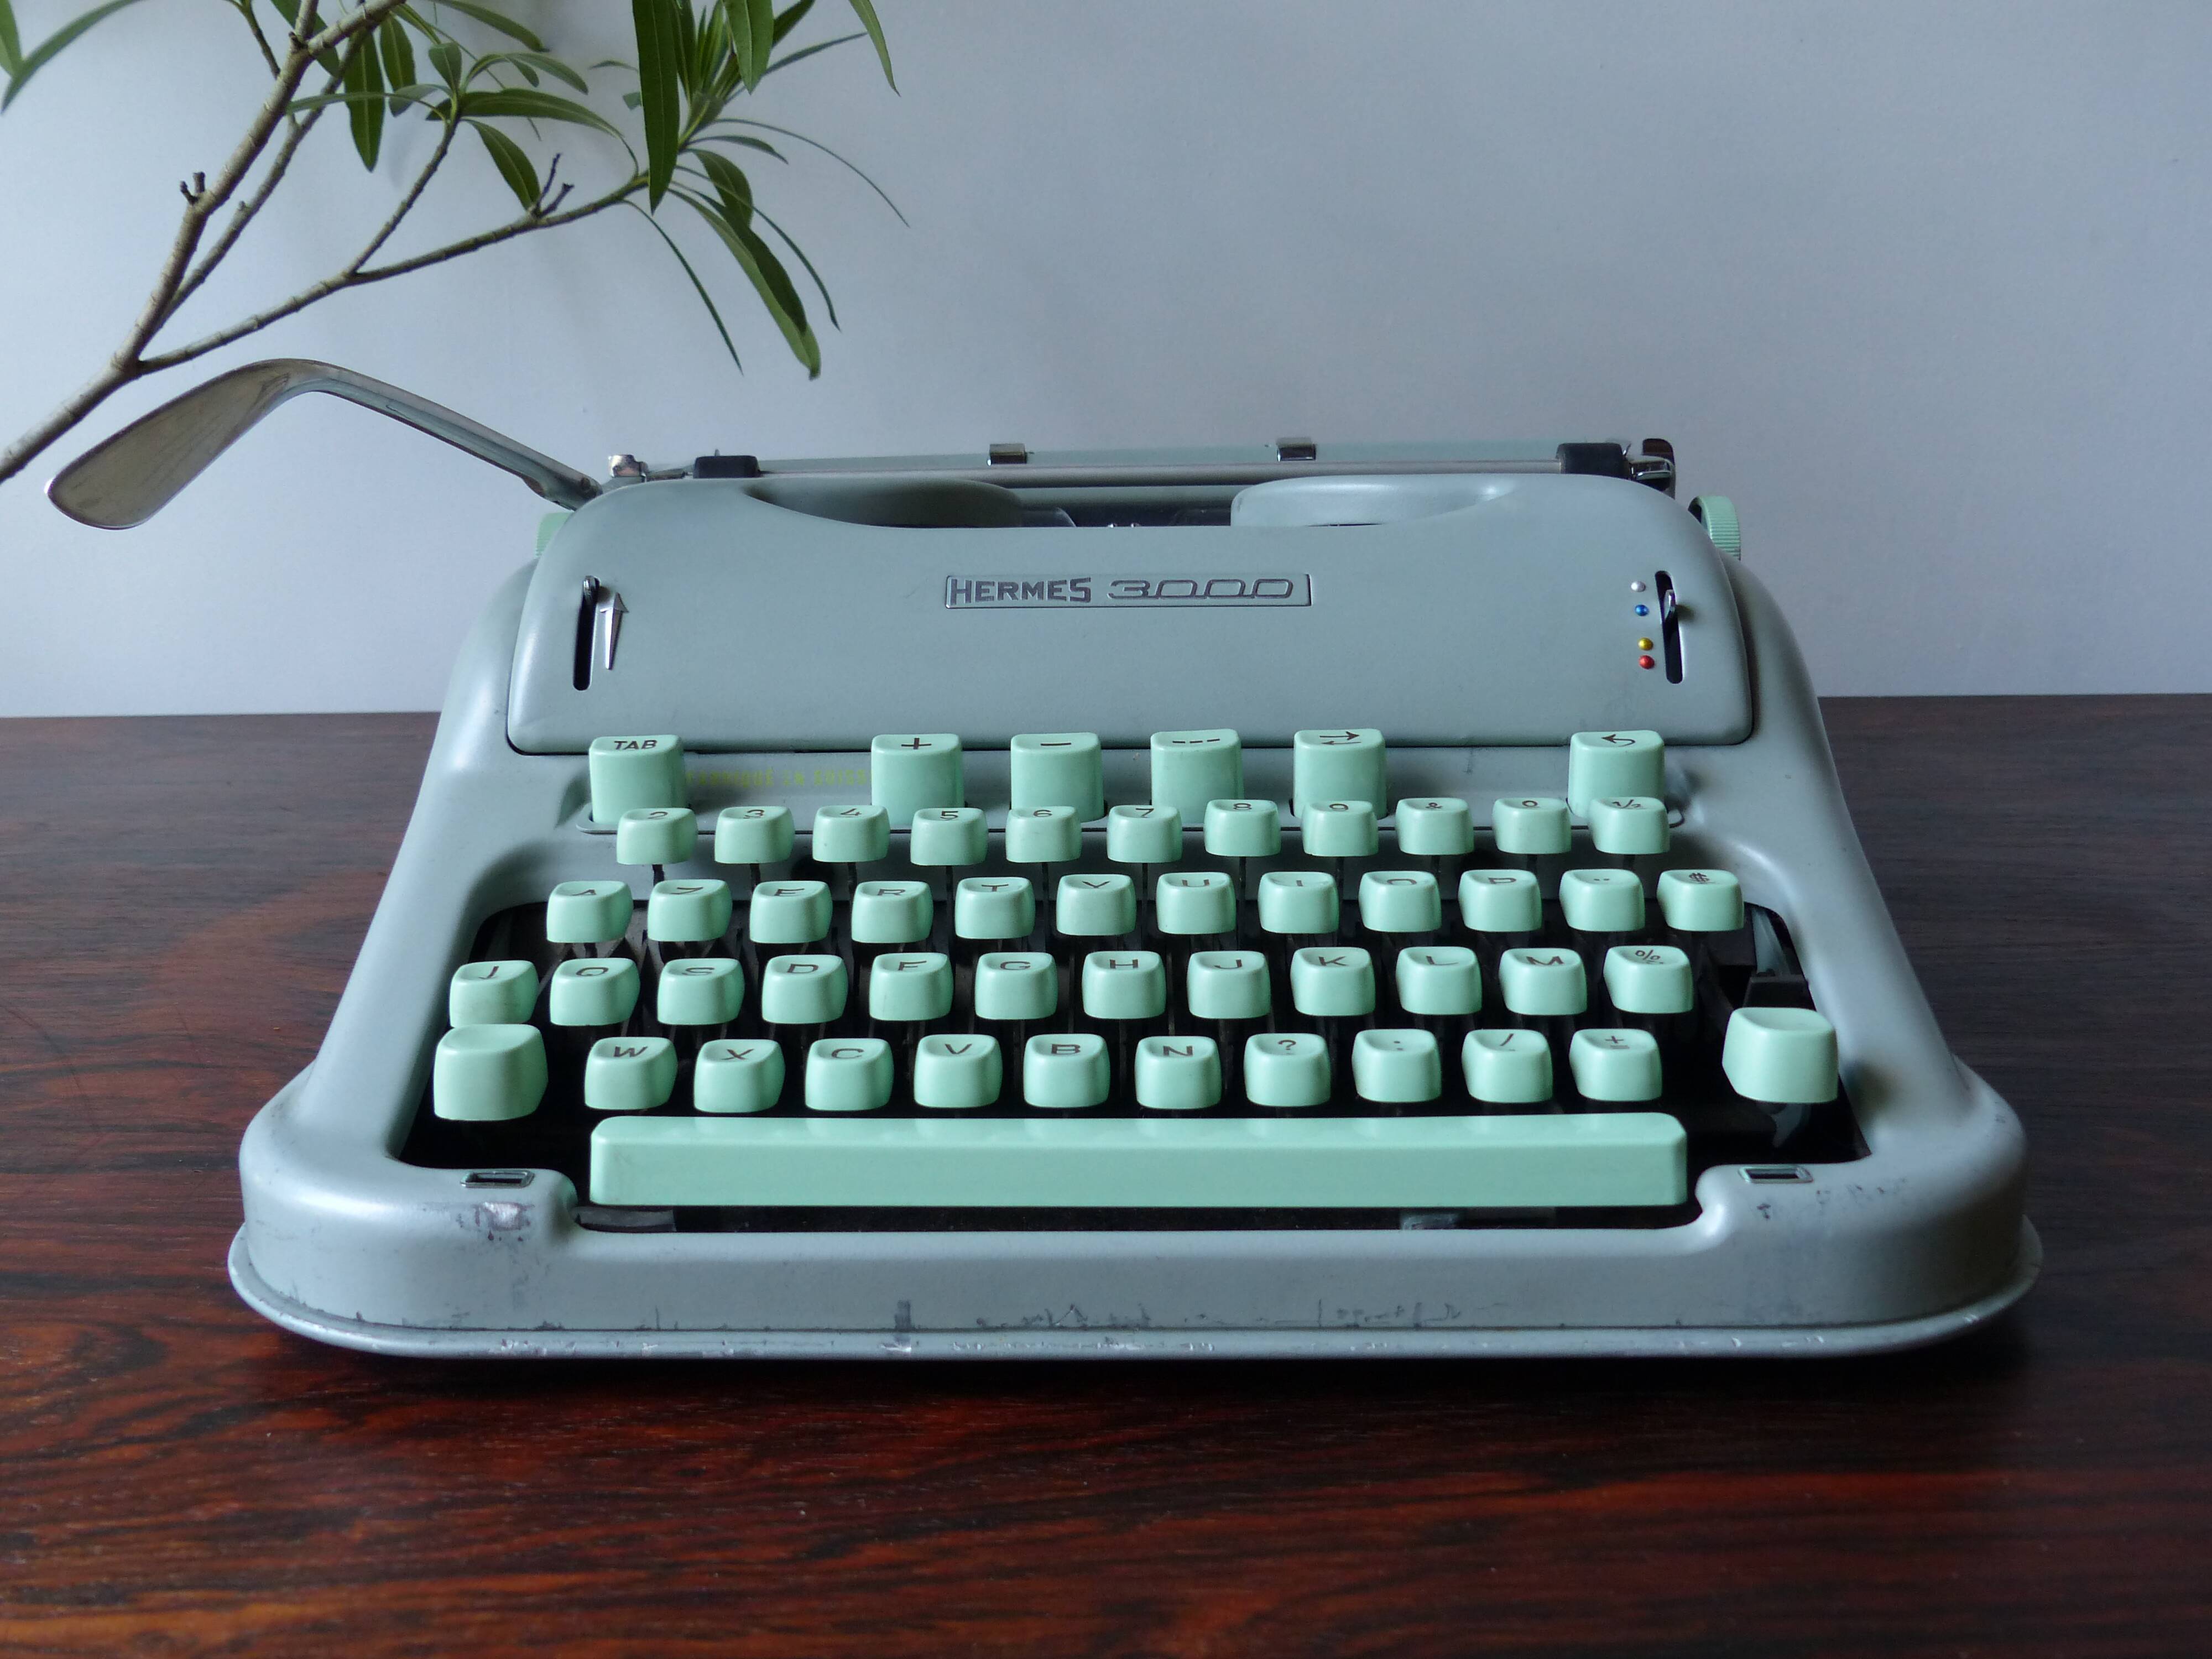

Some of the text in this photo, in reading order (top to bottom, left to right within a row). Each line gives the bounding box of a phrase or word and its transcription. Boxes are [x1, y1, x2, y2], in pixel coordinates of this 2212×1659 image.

[950, 577, 1293, 604] HERMES 3000
[614, 740, 658, 750] TAB
[1233, 803, 1252, 811] 8
[647, 811, 668, 820] 2
[743, 810, 764, 818] 3
[840, 808, 862, 817] 4
[940, 811, 958, 821] 5
[1135, 808, 1154, 818] 7
[773, 888, 805, 896] E
[898, 961, 927, 971] F
[999, 961, 1031, 970] G
[1109, 959, 1139, 969] H
[1213, 959, 1243, 969] J
[1317, 956, 1348, 966] K
[1426, 956, 1458, 966] L
[1525, 956, 1564, 966] M
[575, 967, 609, 977] Q
[683, 967, 715, 975] S
[786, 963, 818, 974] D
[613, 1046, 648, 1058] W
[721, 1049, 754, 1060] X
[831, 1048, 864, 1059] C
[945, 1044, 972, 1055] V
[1051, 1044, 1081, 1055] B
[1162, 1046, 1193, 1057] N
